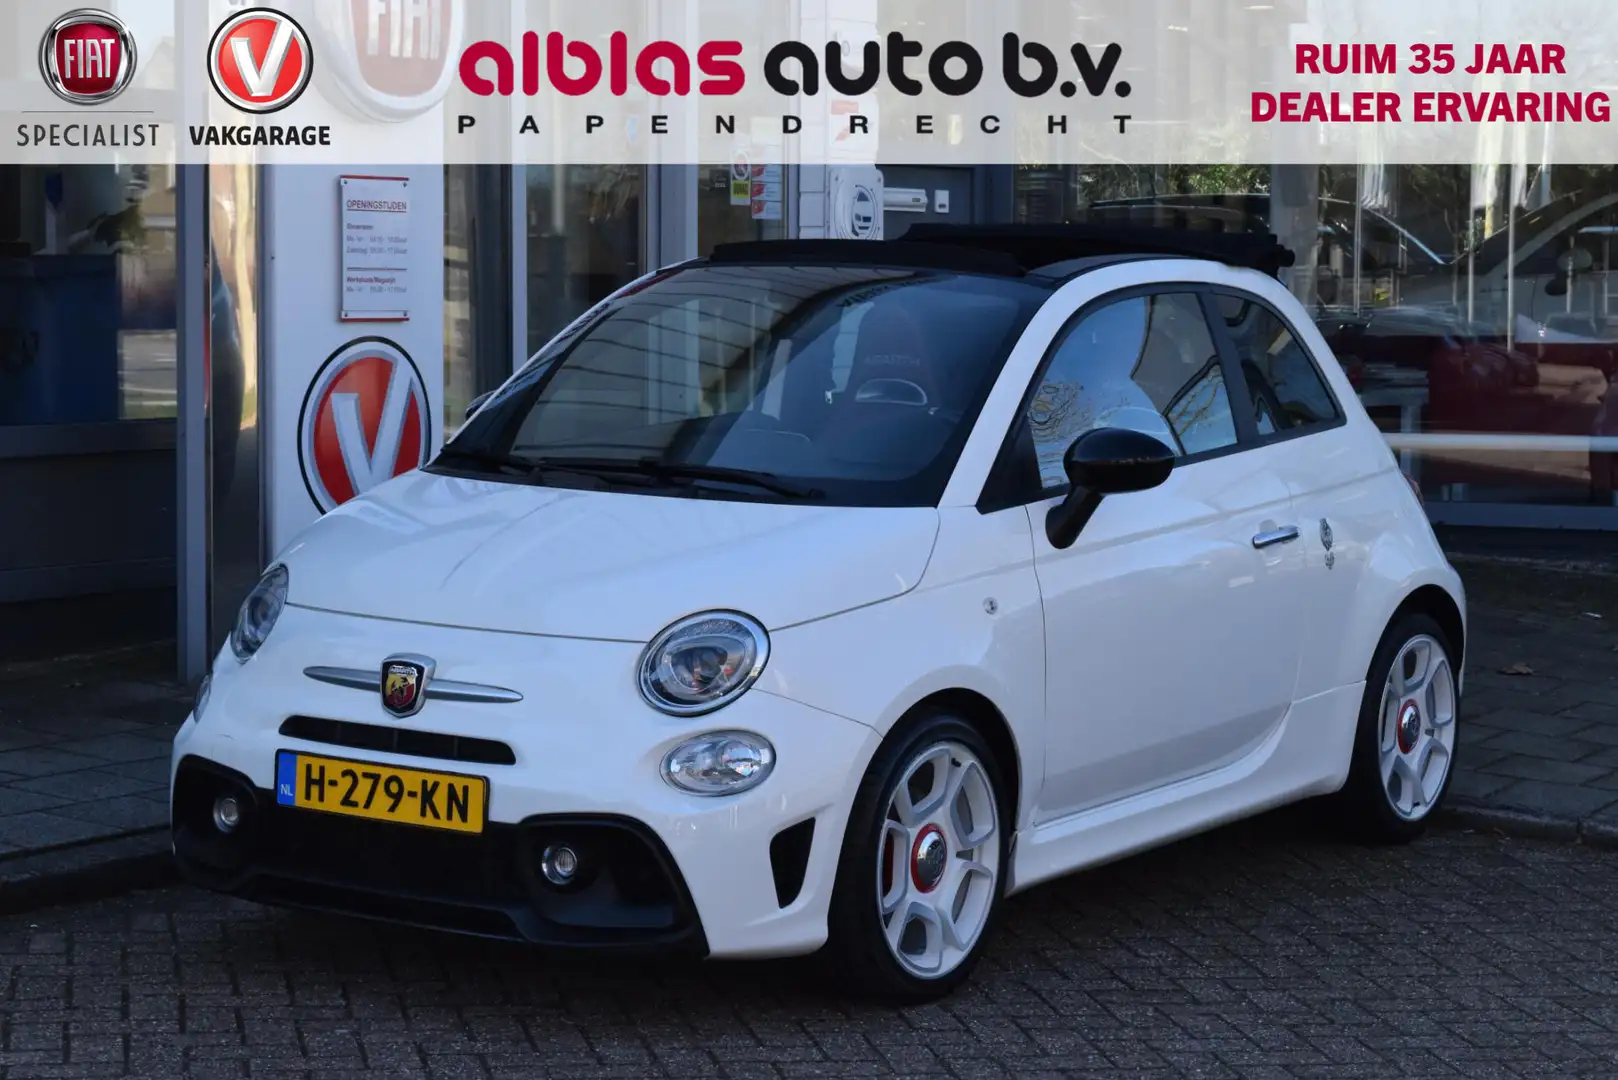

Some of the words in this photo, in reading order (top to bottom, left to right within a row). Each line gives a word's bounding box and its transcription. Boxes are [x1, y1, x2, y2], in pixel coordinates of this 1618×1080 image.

[346, 199, 407, 210] OPENINGSTIJDEN
[280, 783, 293, 797] NL
[304, 763, 469, 823] H-279-KN
